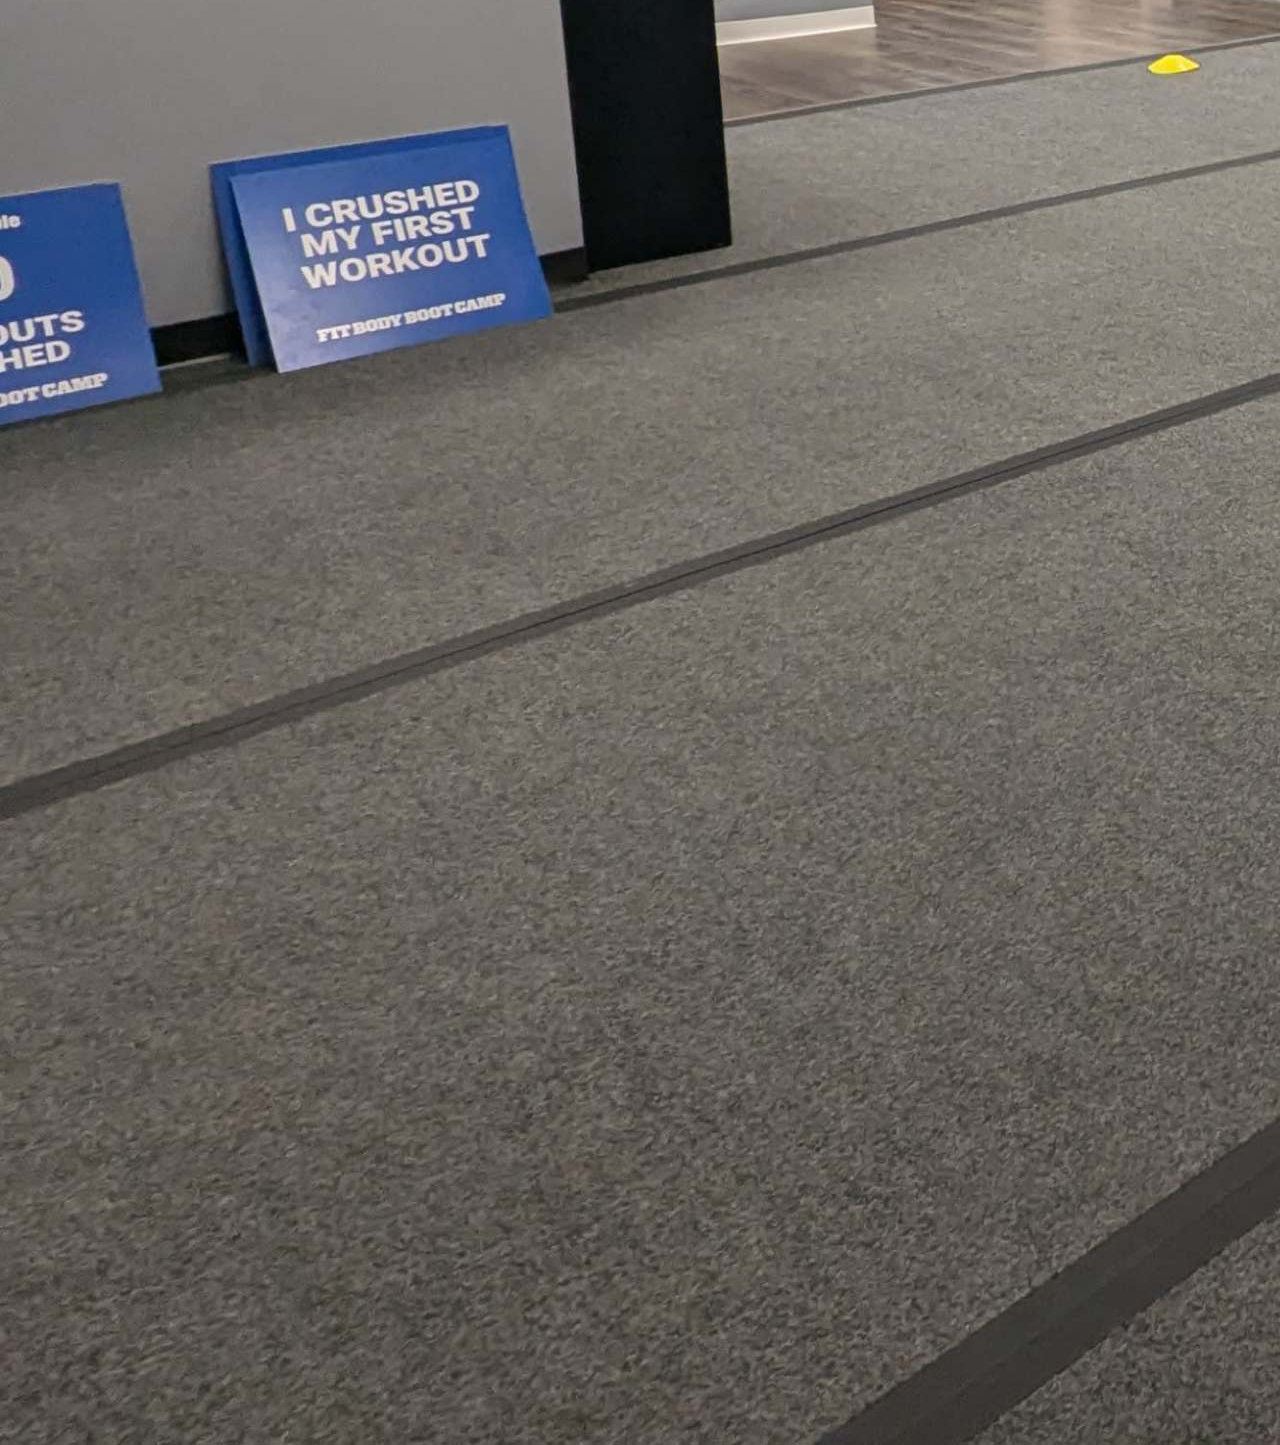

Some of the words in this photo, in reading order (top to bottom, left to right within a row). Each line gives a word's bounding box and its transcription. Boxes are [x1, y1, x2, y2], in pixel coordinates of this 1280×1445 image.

[281, 208, 297, 233] I
[305, 179, 480, 228] CRUSHED
[301, 225, 361, 258] MY
[371, 206, 475, 246] FIRST
[301, 233, 490, 289] WORKOUT
[316, 324, 351, 343] FIT
[351, 314, 402, 336] BODY
[404, 304, 454, 325] BOOT
[454, 292, 506, 314] CAMP
[41, 372, 108, 398] CAMP
